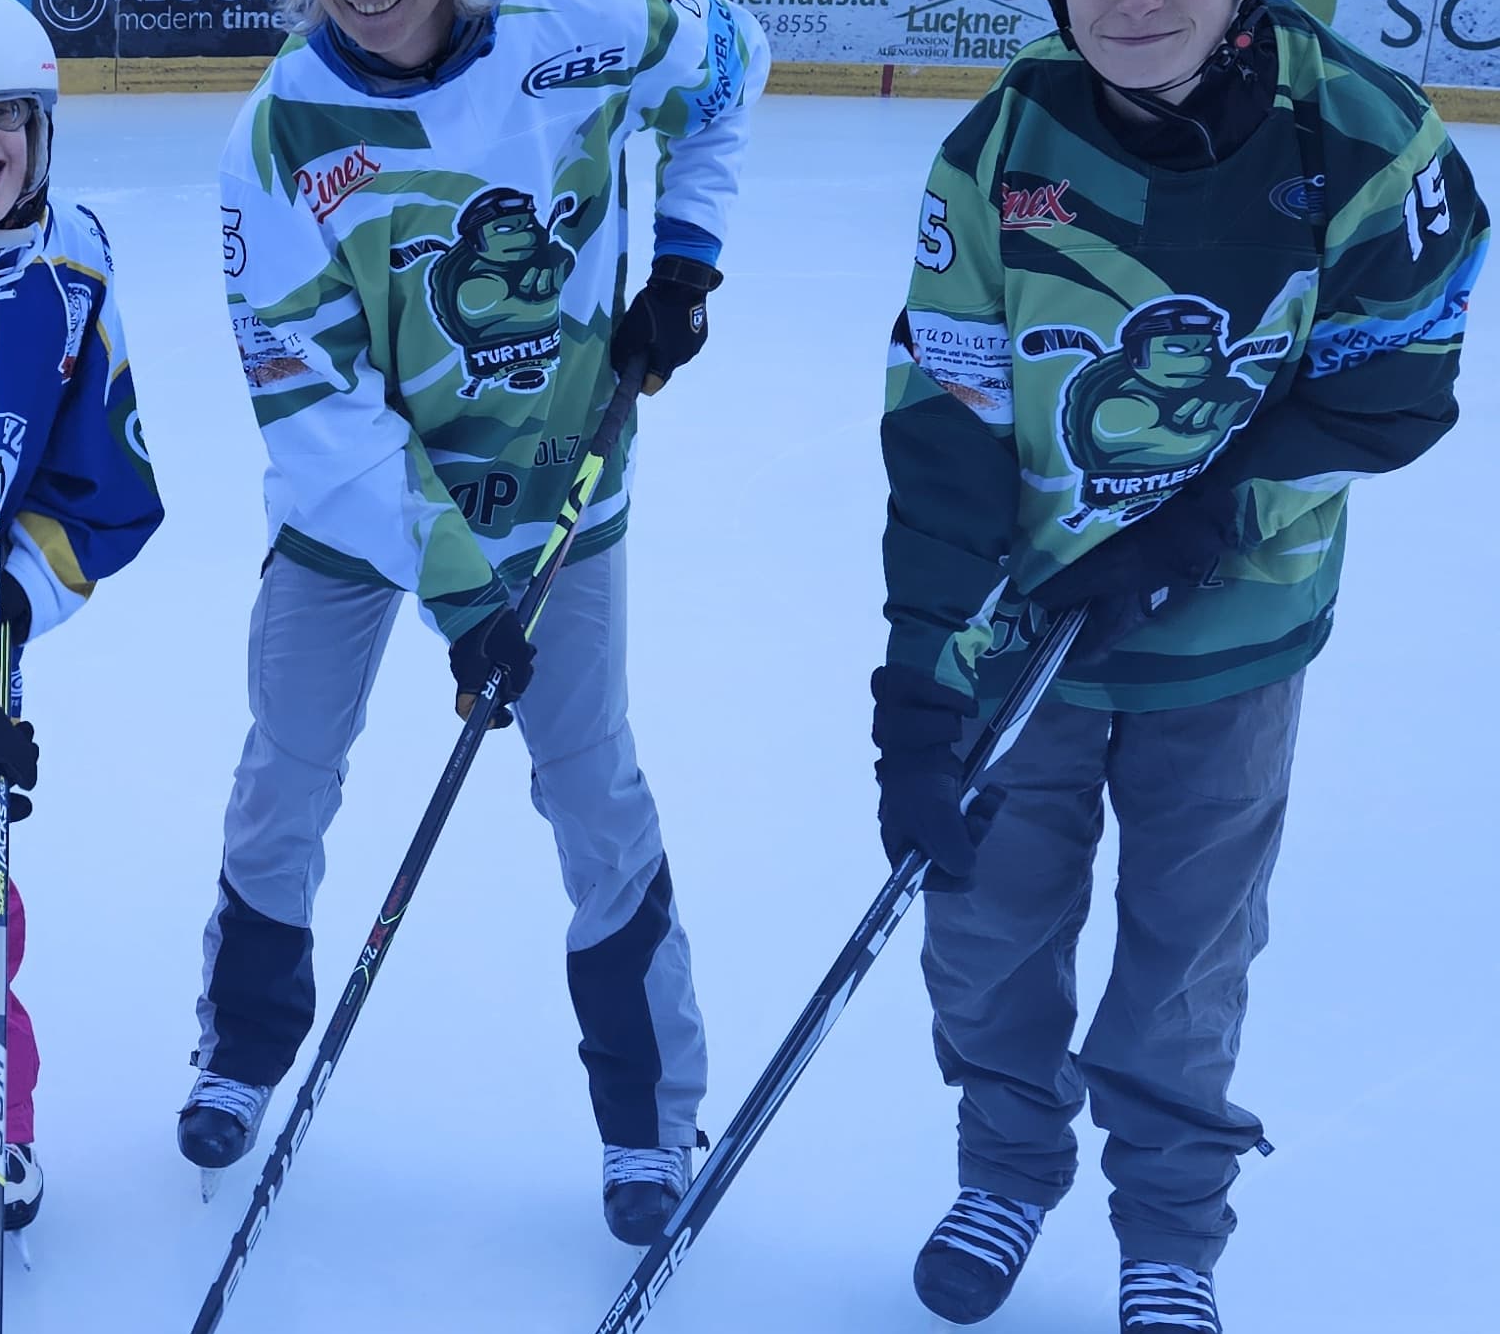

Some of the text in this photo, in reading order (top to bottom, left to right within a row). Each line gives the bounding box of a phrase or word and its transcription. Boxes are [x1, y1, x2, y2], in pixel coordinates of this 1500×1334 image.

[113, 4, 213, 30] modern
[775, 13, 828, 34] 8555
[906, 5, 1023, 36] Luckner
[952, 34, 1021, 61] haus
[470, 329, 561, 367] TURTLES
[1090, 463, 1202, 495] TURTLES
